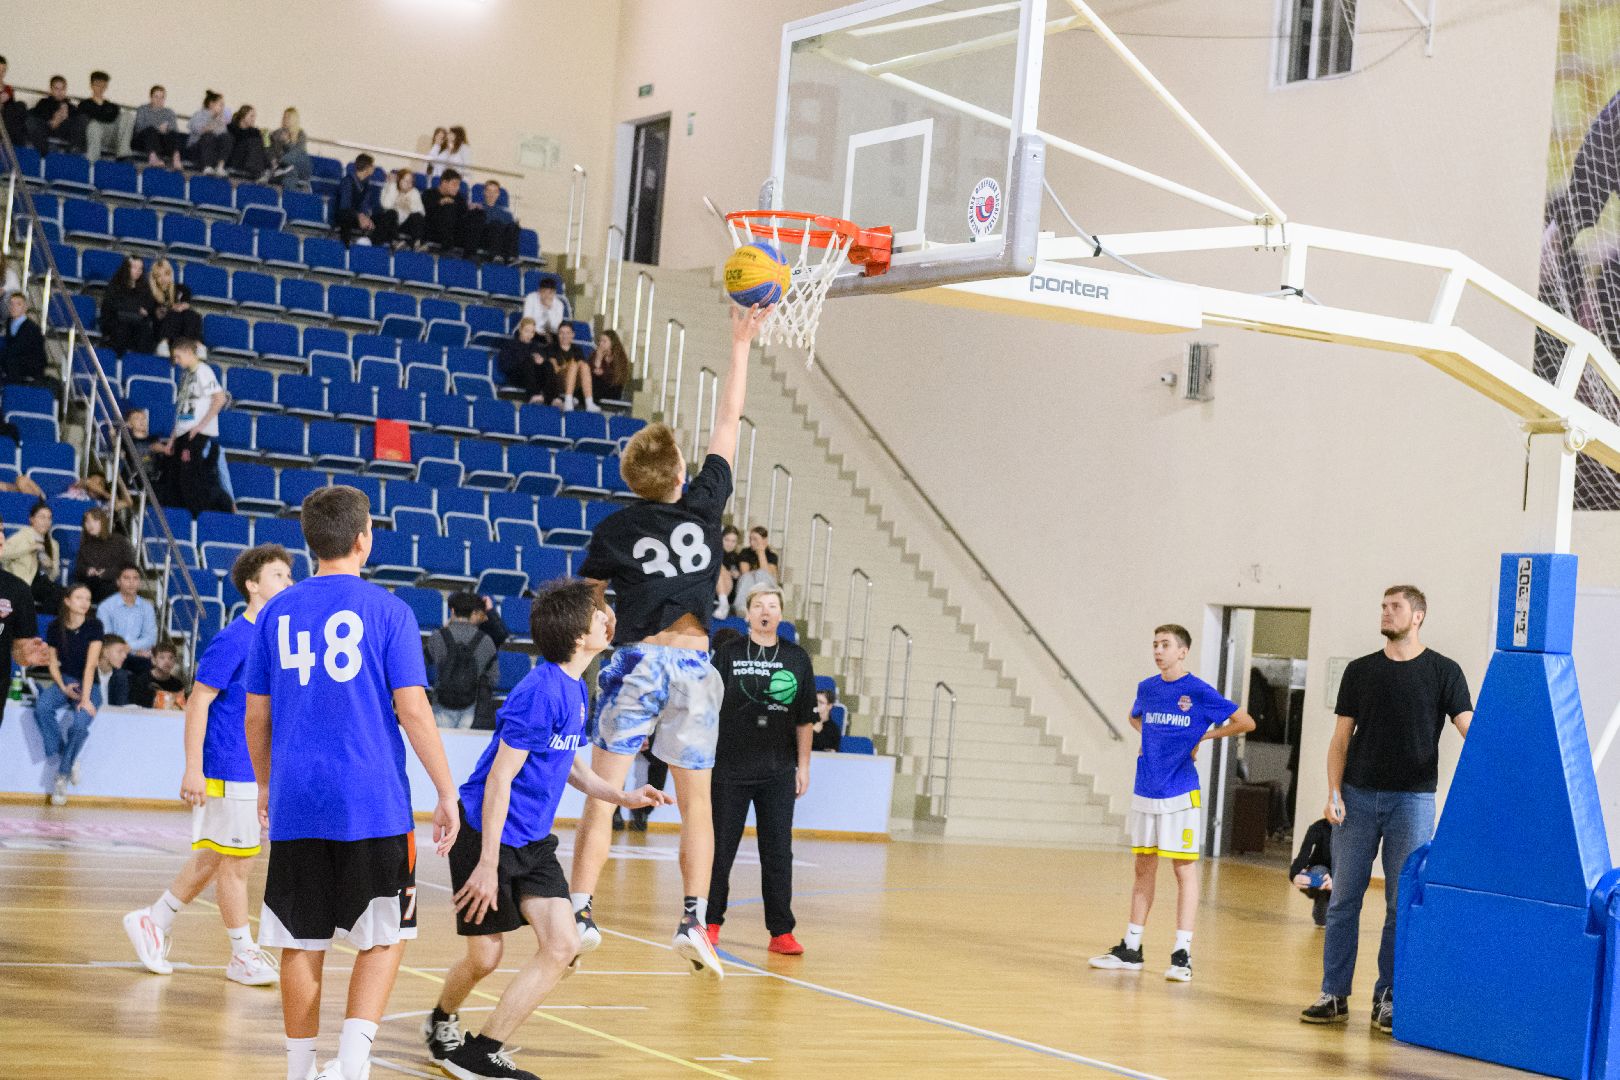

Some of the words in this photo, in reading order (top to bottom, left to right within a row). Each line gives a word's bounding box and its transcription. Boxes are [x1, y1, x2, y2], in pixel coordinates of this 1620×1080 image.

[632, 522, 713, 578] 38
[277, 609, 364, 686] 48
[733, 660, 783, 668] история
[733, 667, 771, 676] побед
[1182, 828, 1194, 849] 9
[403, 886, 417, 920] 7
